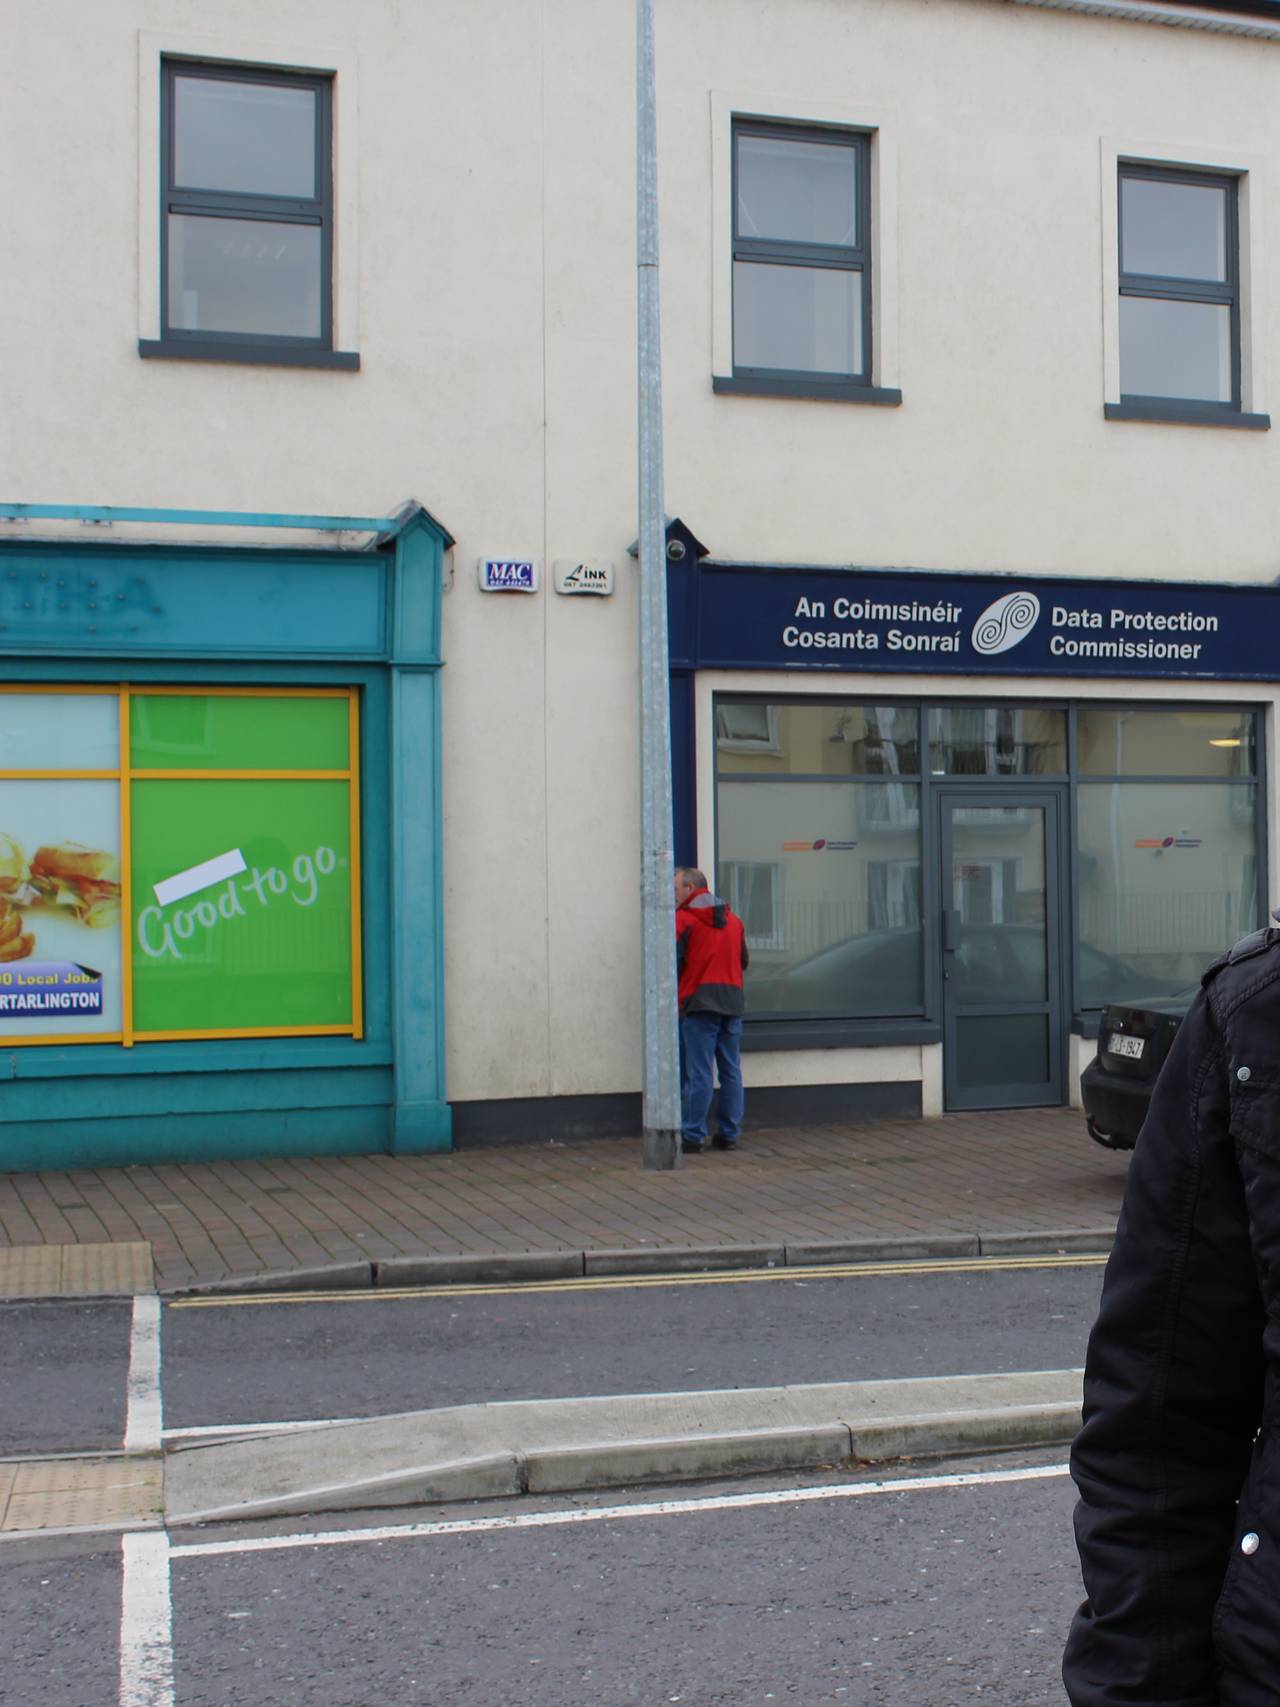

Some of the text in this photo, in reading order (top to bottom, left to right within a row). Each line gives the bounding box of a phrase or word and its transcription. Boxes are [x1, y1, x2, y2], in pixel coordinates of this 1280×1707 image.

[490, 563, 530, 580] MAC
[795, 597, 825, 618] An
[1052, 606, 1218, 632] Data Protection
[783, 626, 961, 652] Cosanta Sonraí
[1050, 635, 1201, 659] Commissioner
[137, 880, 246, 959] Good
[242, 867, 287, 905] to
[18, 973, 58, 984] Local
[0, 992, 99, 1009] RTARLINGTON
